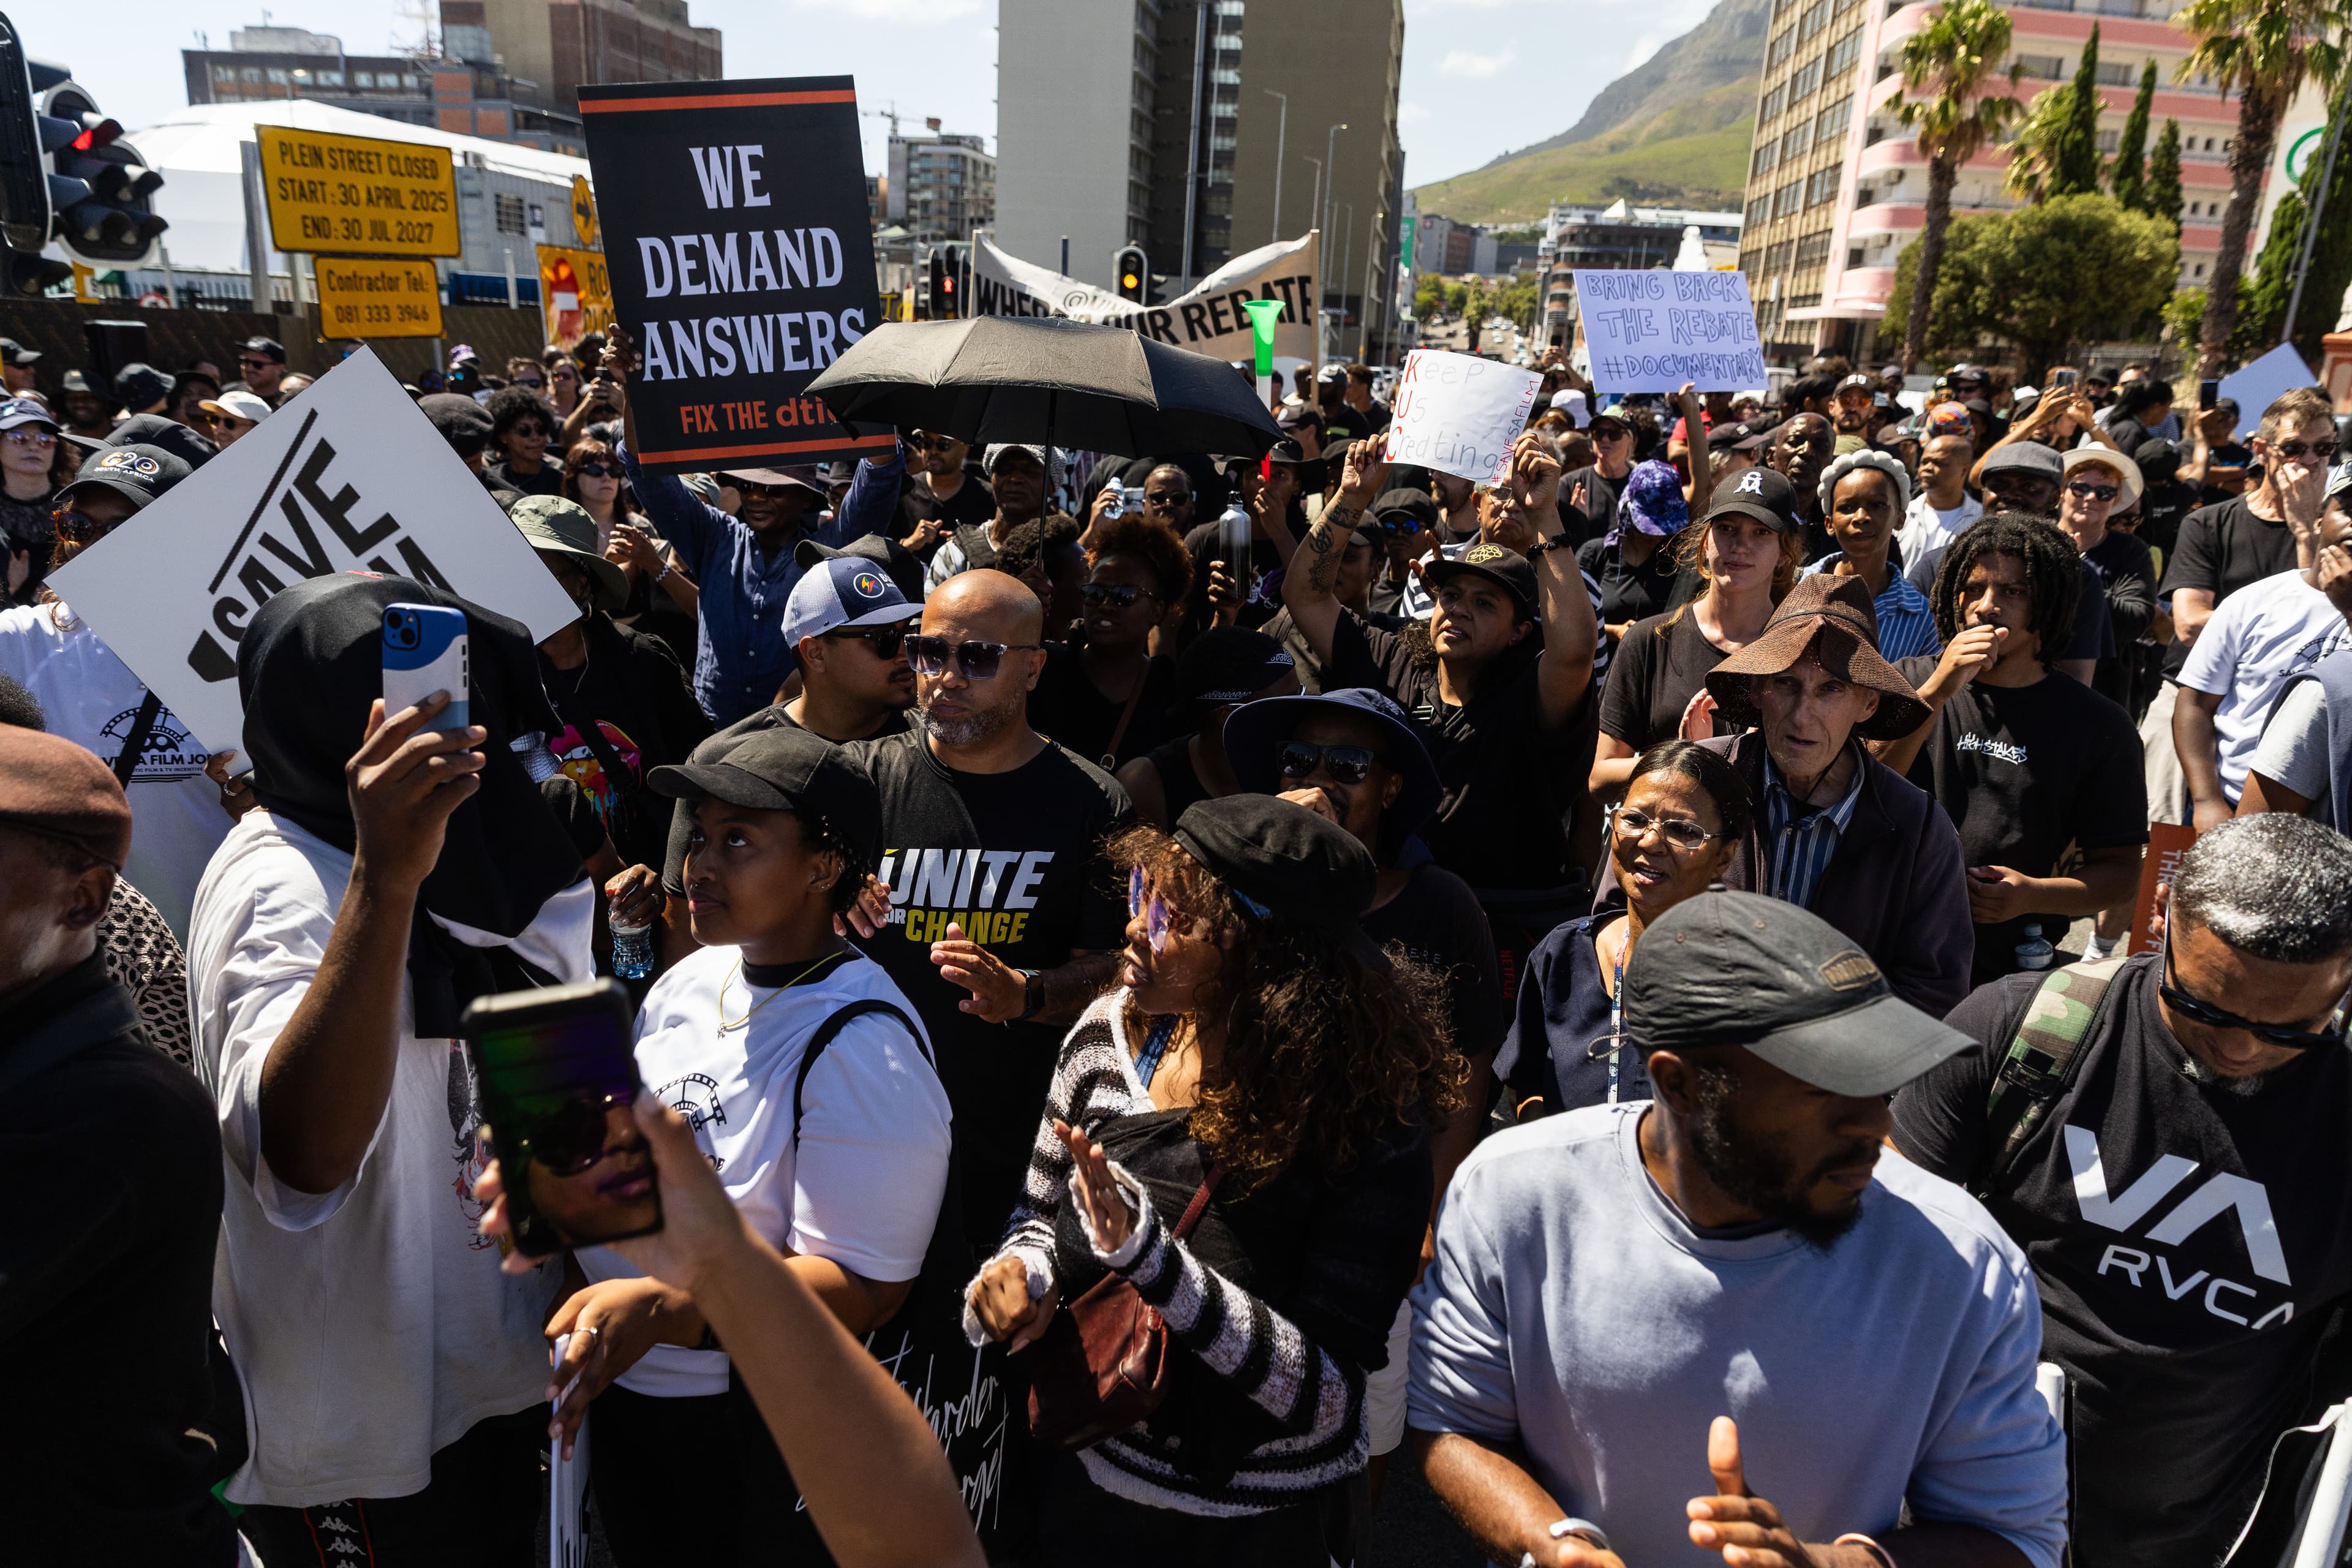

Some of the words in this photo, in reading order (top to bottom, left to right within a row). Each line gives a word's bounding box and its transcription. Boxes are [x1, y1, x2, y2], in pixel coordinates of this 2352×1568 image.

[279, 141, 324, 168] PLEIN
[328, 147, 382, 175] STREET
[387, 154, 439, 181] CLOSED
[688, 145, 771, 209] WE
[337, 183, 360, 207] 30
[366, 186, 406, 211] APRIL
[410, 189, 448, 213] 2025
[340, 217, 363, 241] 30
[369, 219, 391, 243] JUL
[396, 221, 434, 244] 2027
[587, 262, 609, 296] RO
[636, 227, 843, 298] DEMAND
[326, 269, 400, 293] Contractor
[1585, 274, 1664, 302] BRING
[1673, 273, 1743, 303] BACK
[336, 305, 360, 323] 081
[364, 304, 391, 323] 333
[1597, 308, 1659, 345] THE
[1668, 308, 1755, 345] REBATE
[642, 308, 865, 382] ANSWERS
[1602, 347, 1765, 383] #DOCUMENTARY
[680, 405, 719, 434] FIX
[722, 401, 769, 431] THE
[100, 451, 159, 475] G20
[123, 469, 155, 483] AFRICA
[151, 754, 183, 765] FILM
[877, 848, 1055, 909] UNITE
[1499, 950, 1516, 1000] NETFLIX
[2097, 1244, 2294, 1330] RVCA
